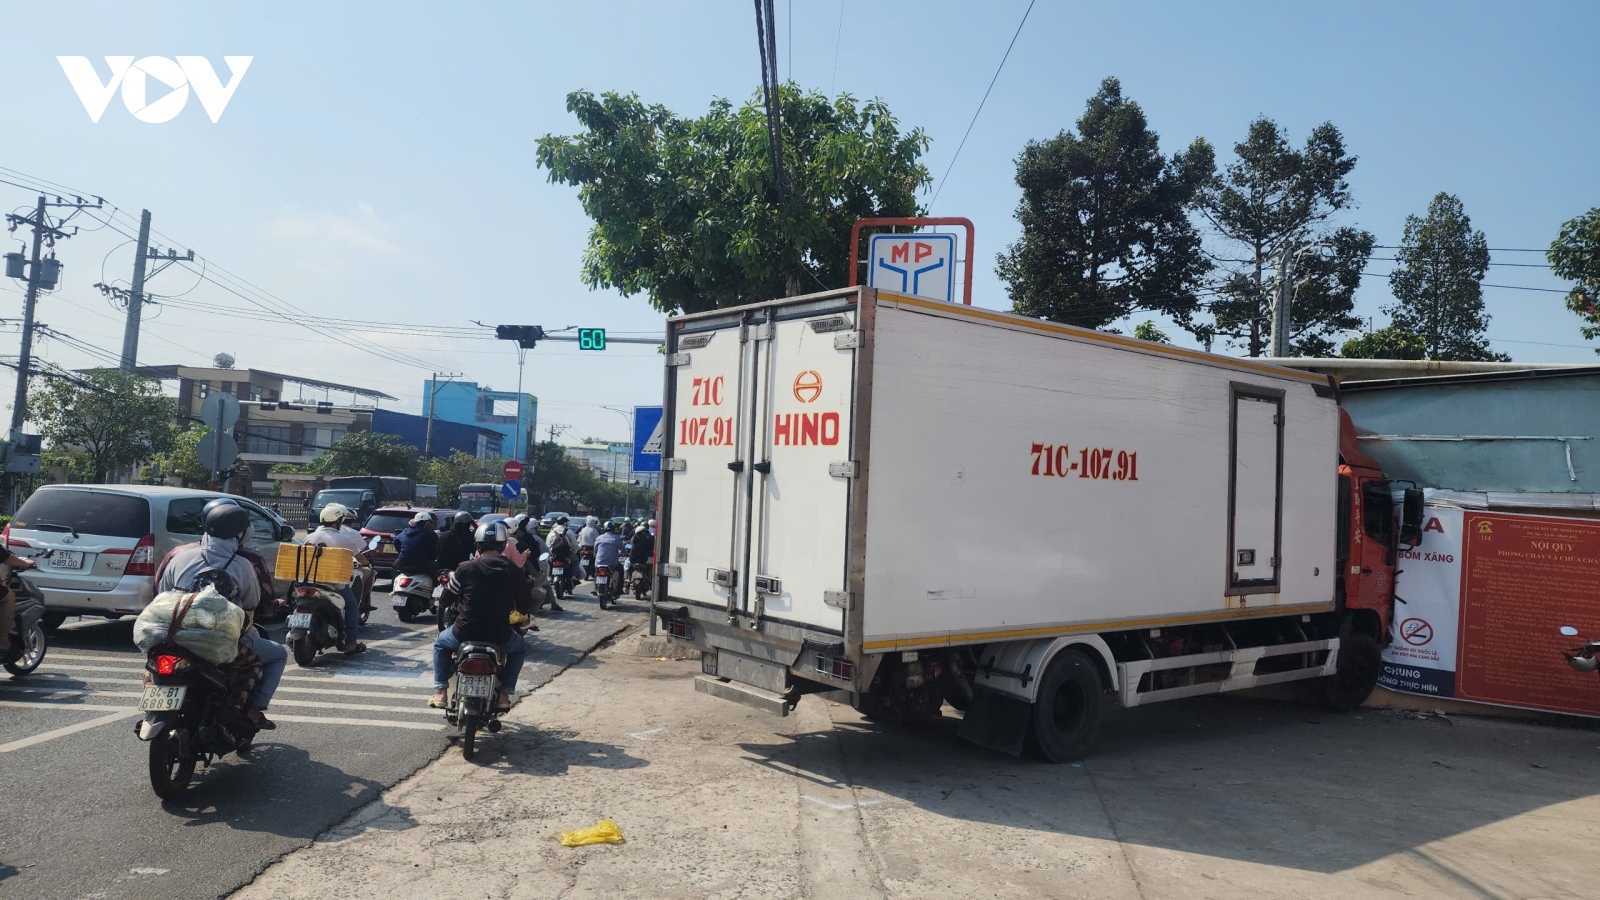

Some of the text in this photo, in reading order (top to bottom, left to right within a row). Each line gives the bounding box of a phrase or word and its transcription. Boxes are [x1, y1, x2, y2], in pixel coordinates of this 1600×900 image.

[581, 329, 604, 350] 60
[692, 375, 724, 406] 71C
[679, 417, 733, 446] 107.91
[774, 411, 840, 446] HINO
[1031, 441, 1138, 481] 71C-107.91
[1531, 540, 1574, 552] NỘI QUY
[1424, 552, 1454, 563] XĂNG
[1384, 665, 1421, 679] CHUNG
[149, 687, 180, 698] 84-B1
[1421, 683, 1438, 692] HIỆN
